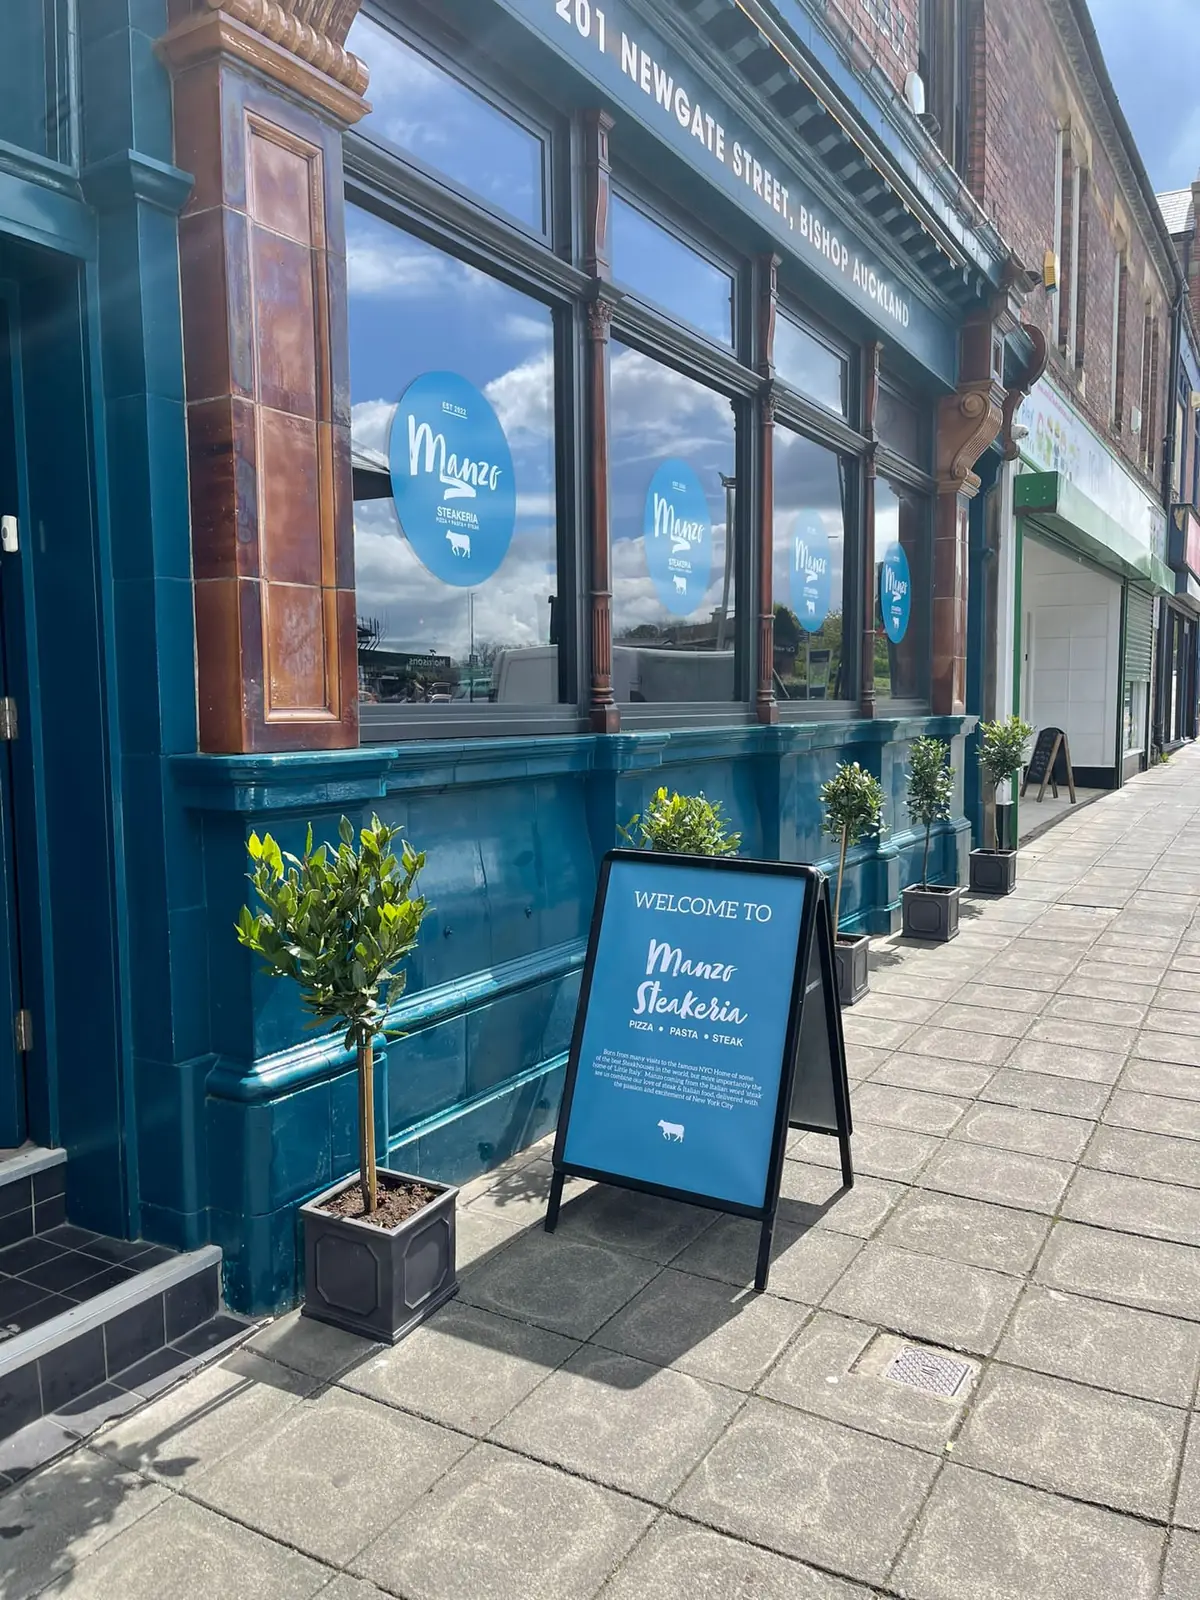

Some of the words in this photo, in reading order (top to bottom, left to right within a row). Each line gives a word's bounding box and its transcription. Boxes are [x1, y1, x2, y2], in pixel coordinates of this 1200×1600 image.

[621, 32, 725, 163] NEWGATE
[732, 141, 796, 231] STREET,
[799, 204, 849, 273] BISHOP
[852, 262, 910, 329] AUCKLAND
[442, 401, 453, 411] EST
[408, 414, 502, 500] Manzo
[437, 505, 479, 524] STEAKERIA
[654, 492, 704, 553] Manzo
[634, 890, 739, 920] WELCOME
[743, 902, 772, 923] TO
[646, 938, 738, 982] Manzo
[633, 980, 748, 1025] Steakeria
[629, 1020, 654, 1032] PIZZA
[669, 1026, 698, 1040] PASTA
[712, 1033, 744, 1047] STEAK
[592, 1062, 607, 1070] home
[644, 1070, 664, 1081] Manzo
[664, 1075, 685, 1086] coming
[685, 1079, 699, 1087] from
[699, 1081, 710, 1089] the
[729, 1088, 745, 1096] word
[602, 1055, 611, 1063] the
[622, 1059, 655, 1072] Steakhouses
[690, 1071, 701, 1080] but
[701, 1074, 716, 1082] more
[716, 1077, 752, 1091] importantly
[751, 1083, 763, 1092] the
[603, 1048, 616, 1057] Born
[617, 1051, 629, 1059] from
[629, 1054, 646, 1063] many
[646, 1056, 661, 1064] visits
[668, 1060, 678, 1068] the
[678, 1062, 698, 1071] famous
[699, 1066, 714, 1075] NYC
[714, 1068, 731, 1078] Home
[739, 1074, 755, 1082] some
[610, 1072, 633, 1083] combine
[643, 1078, 655, 1087] love
[662, 1083, 677, 1091] steak
[682, 1085, 701, 1095] Italian
[715, 1092, 744, 1104] delivered
[744, 1098, 759, 1106] with
[623, 1082, 644, 1092] passion
[643, 1086, 655, 1095] and
[655, 1088, 685, 1100] excitement
[692, 1094, 706, 1104] New
[706, 1097, 721, 1107] York
[720, 1100, 734, 1111] City
